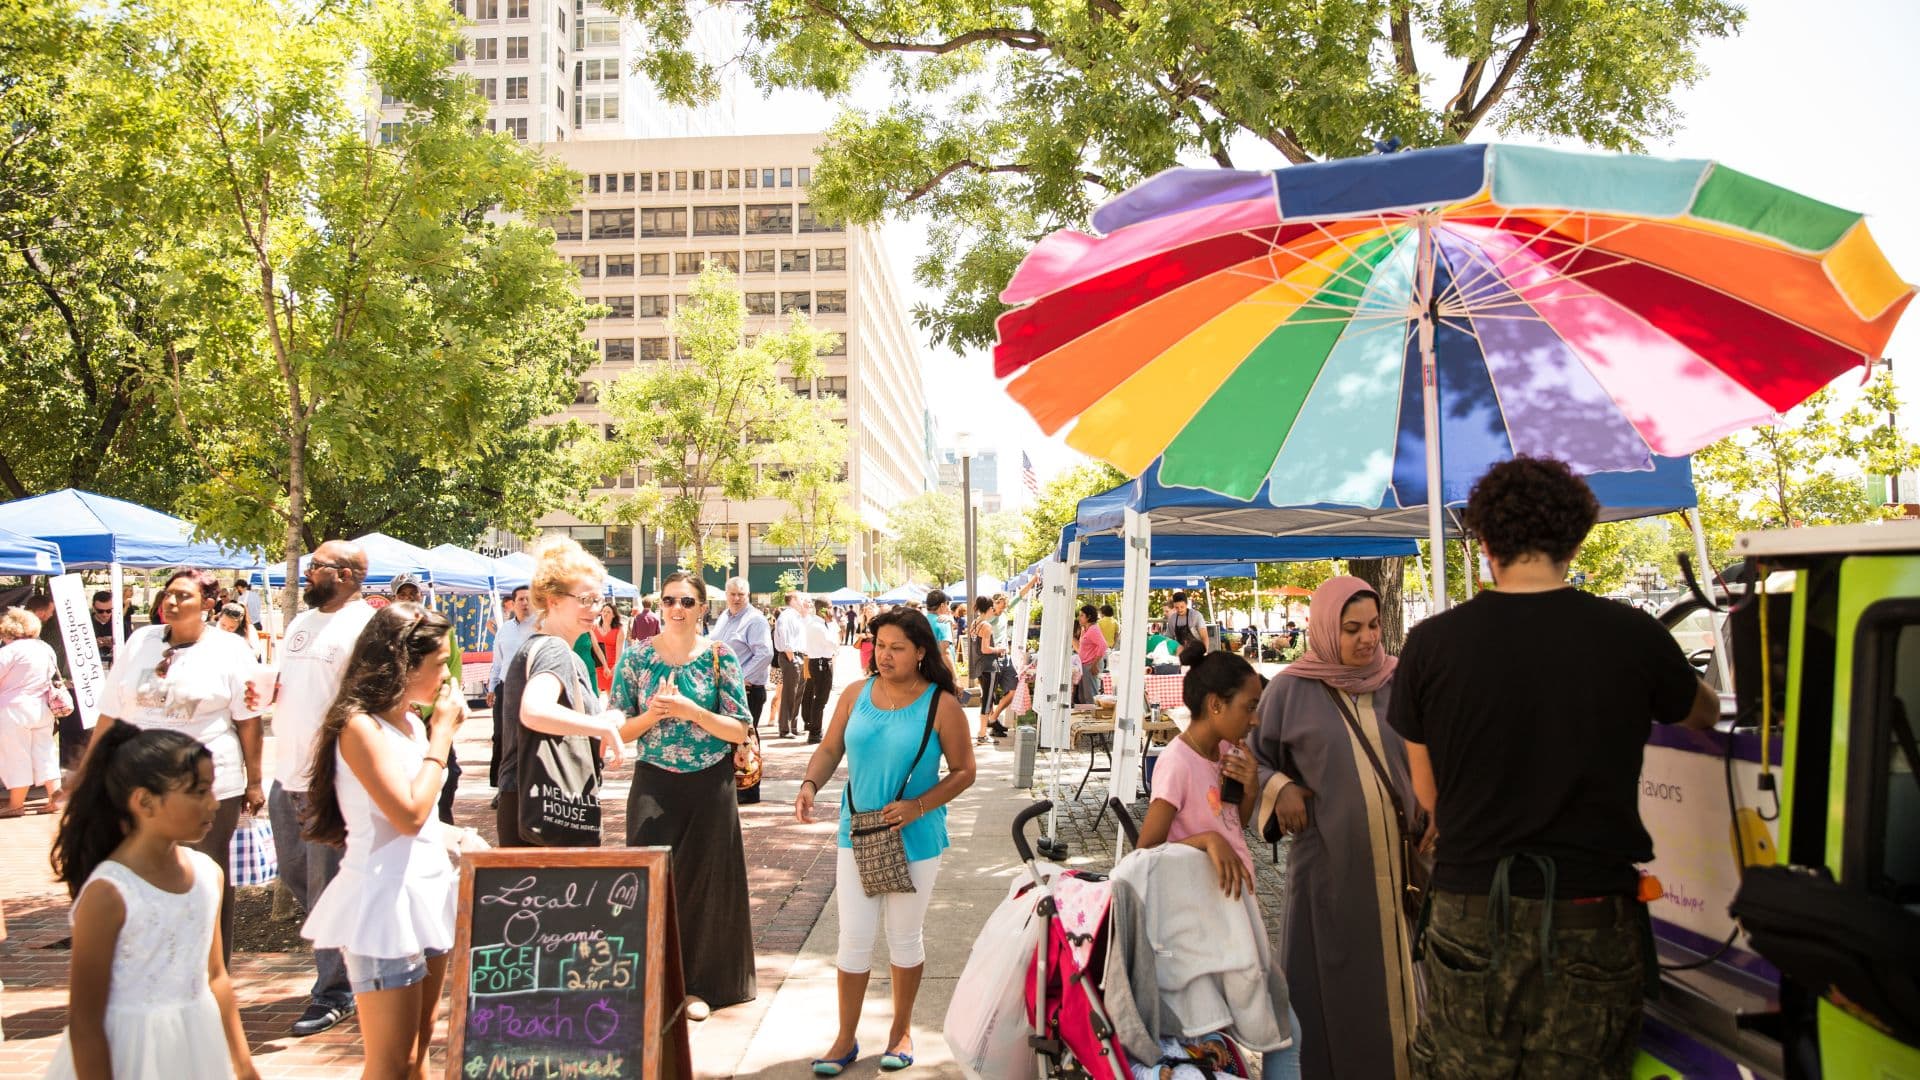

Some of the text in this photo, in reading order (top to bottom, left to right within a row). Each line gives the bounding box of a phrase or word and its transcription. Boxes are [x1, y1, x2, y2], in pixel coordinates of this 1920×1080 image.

[64, 599, 95, 708] Cake Cre8tions
[78, 623, 99, 680] by Carol
[543, 784, 601, 807] MELVILLE
[1639, 777, 1682, 803] lavors
[543, 800, 587, 822] HOUSE
[504, 909, 609, 952] Organic
[479, 946, 534, 970] ICE
[472, 968, 536, 992] POPS
[567, 960, 631, 991] 2 for 5
[498, 998, 573, 1039] Peach
[487, 1053, 539, 1080] Mint
